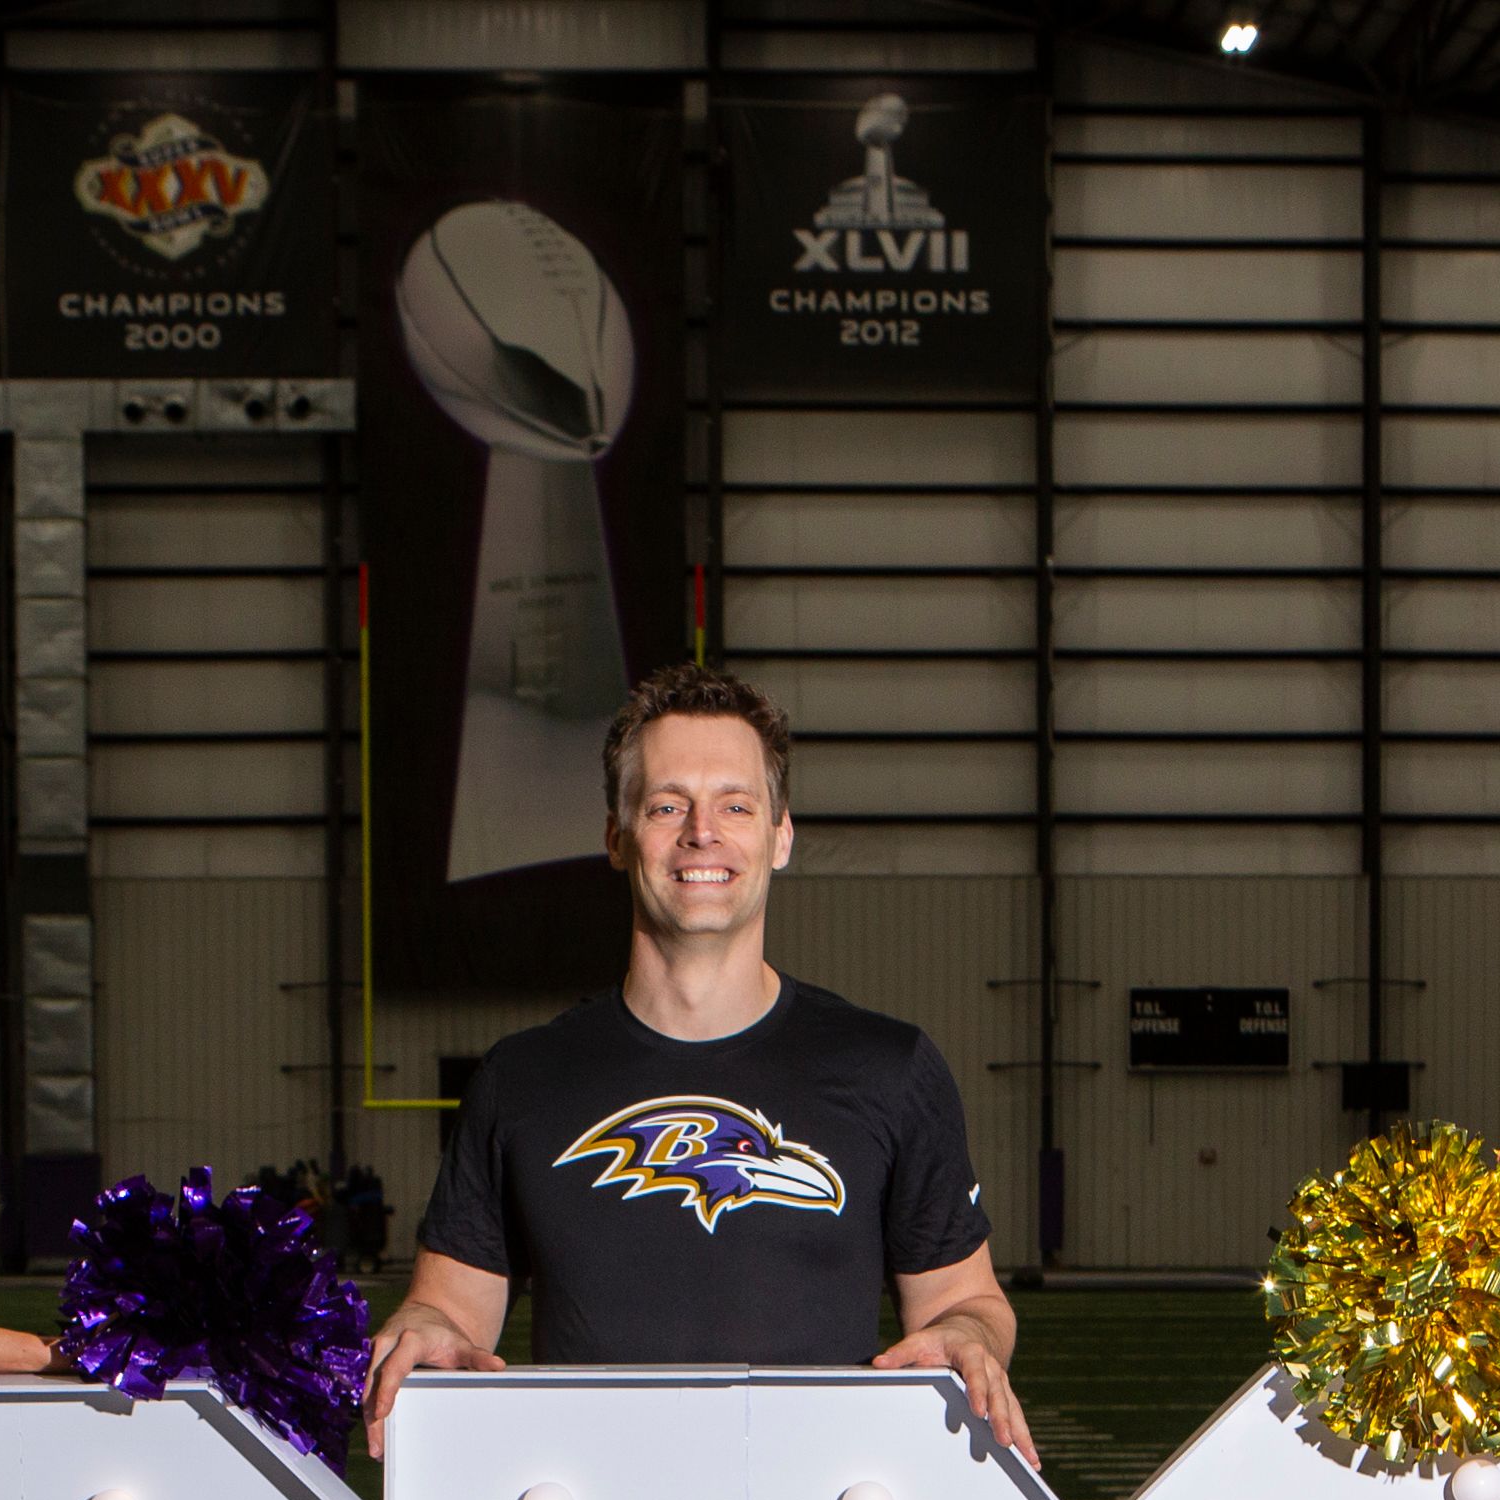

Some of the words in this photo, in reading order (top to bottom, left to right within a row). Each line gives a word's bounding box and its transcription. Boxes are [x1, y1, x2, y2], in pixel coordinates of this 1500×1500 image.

[99, 157, 248, 217] XXXV
[793, 229, 970, 272] XLVII
[58, 292, 287, 317] CHAMPIONS
[769, 289, 990, 314] CHAMPIONS
[124, 323, 222, 350] 2000
[840, 319, 921, 346] 2012
[629, 1112, 719, 1166] B
